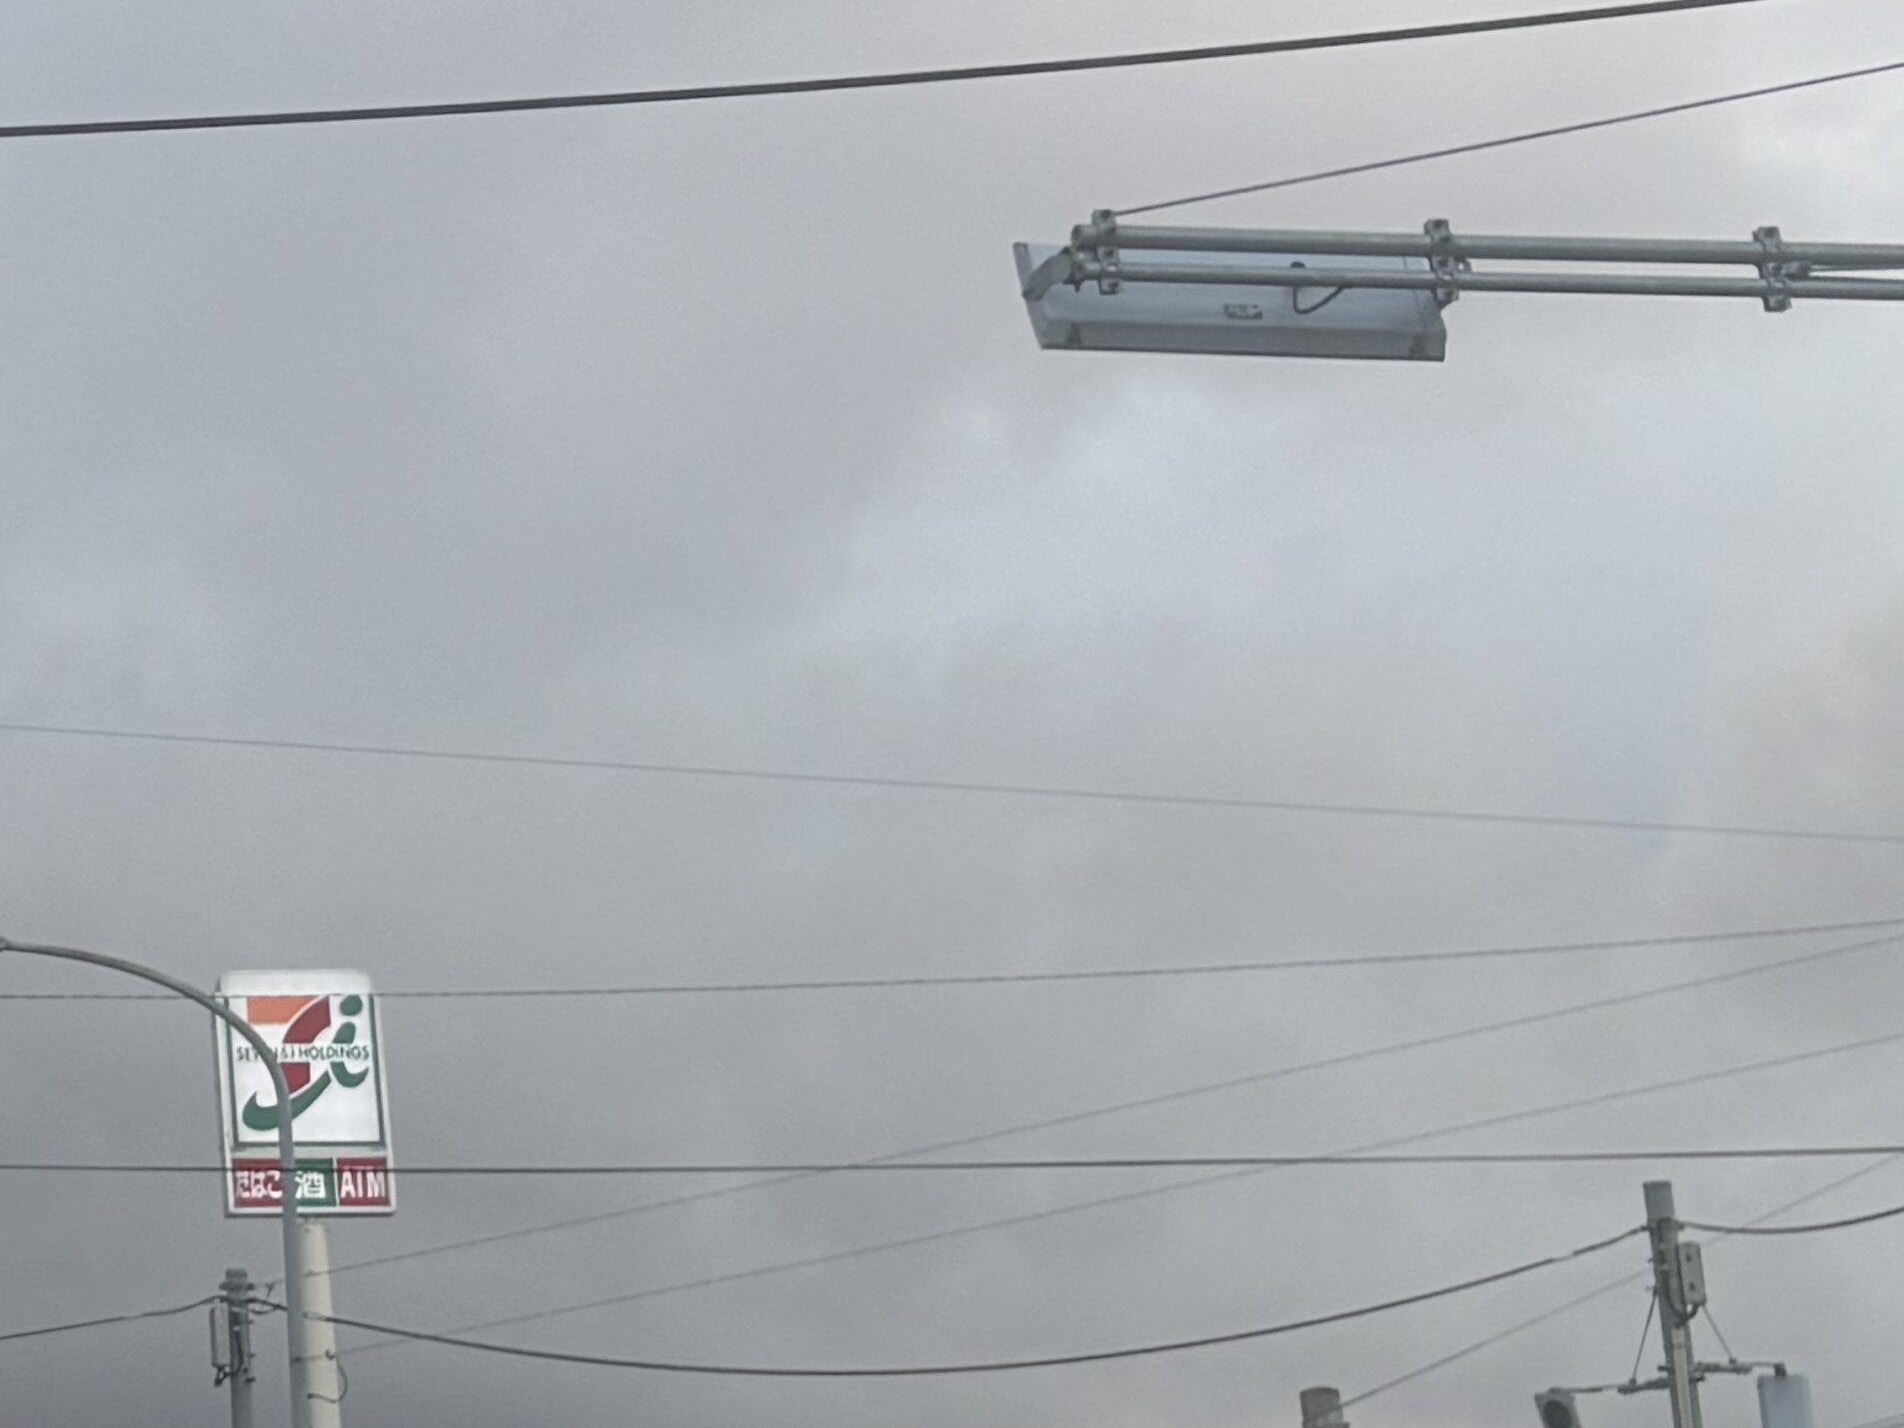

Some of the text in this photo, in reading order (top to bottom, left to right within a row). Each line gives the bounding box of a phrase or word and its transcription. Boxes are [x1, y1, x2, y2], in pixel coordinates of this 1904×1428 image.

[298, 1045, 370, 1061] HOLDINGS
[294, 1170, 327, 1199] 酒
[340, 1166, 387, 1199] ATM
